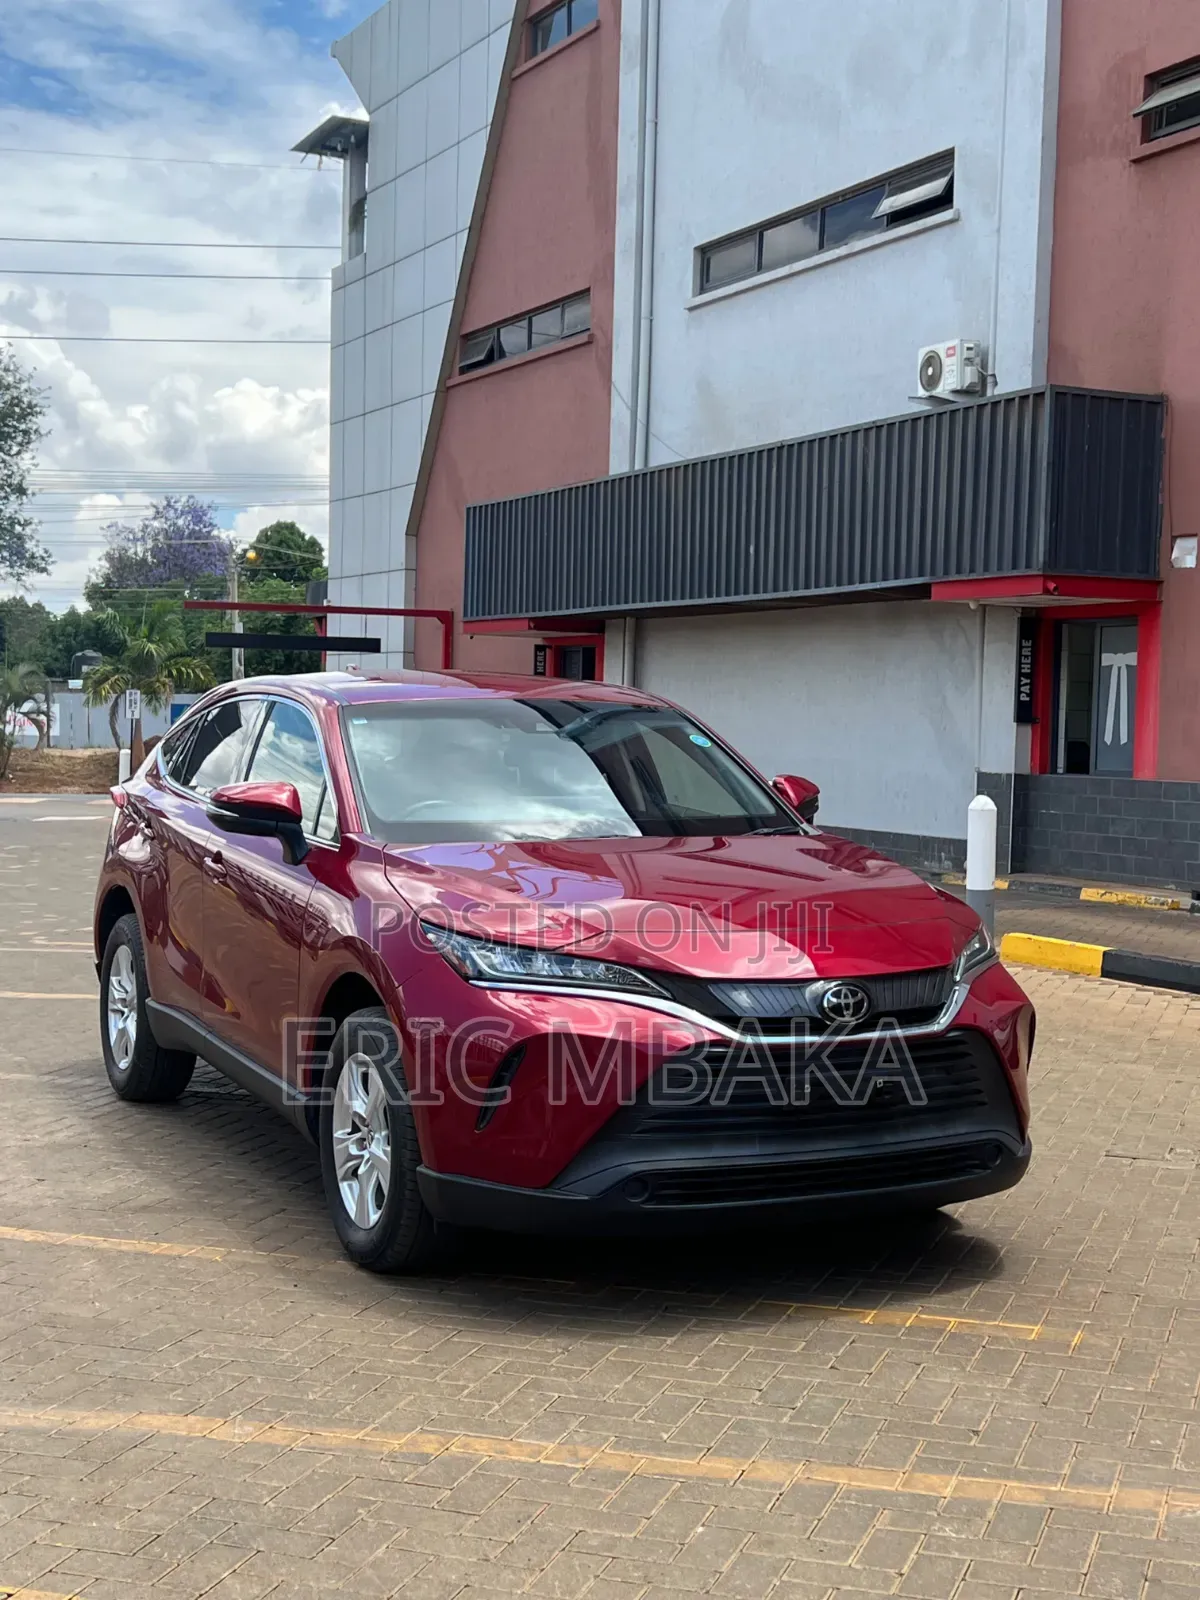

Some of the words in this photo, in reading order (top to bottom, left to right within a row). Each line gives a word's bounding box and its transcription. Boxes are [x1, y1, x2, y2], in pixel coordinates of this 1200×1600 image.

[536, 651, 544, 672] HERE
[1021, 639, 1032, 673] HERE
[1020, 677, 1030, 701] PAY
